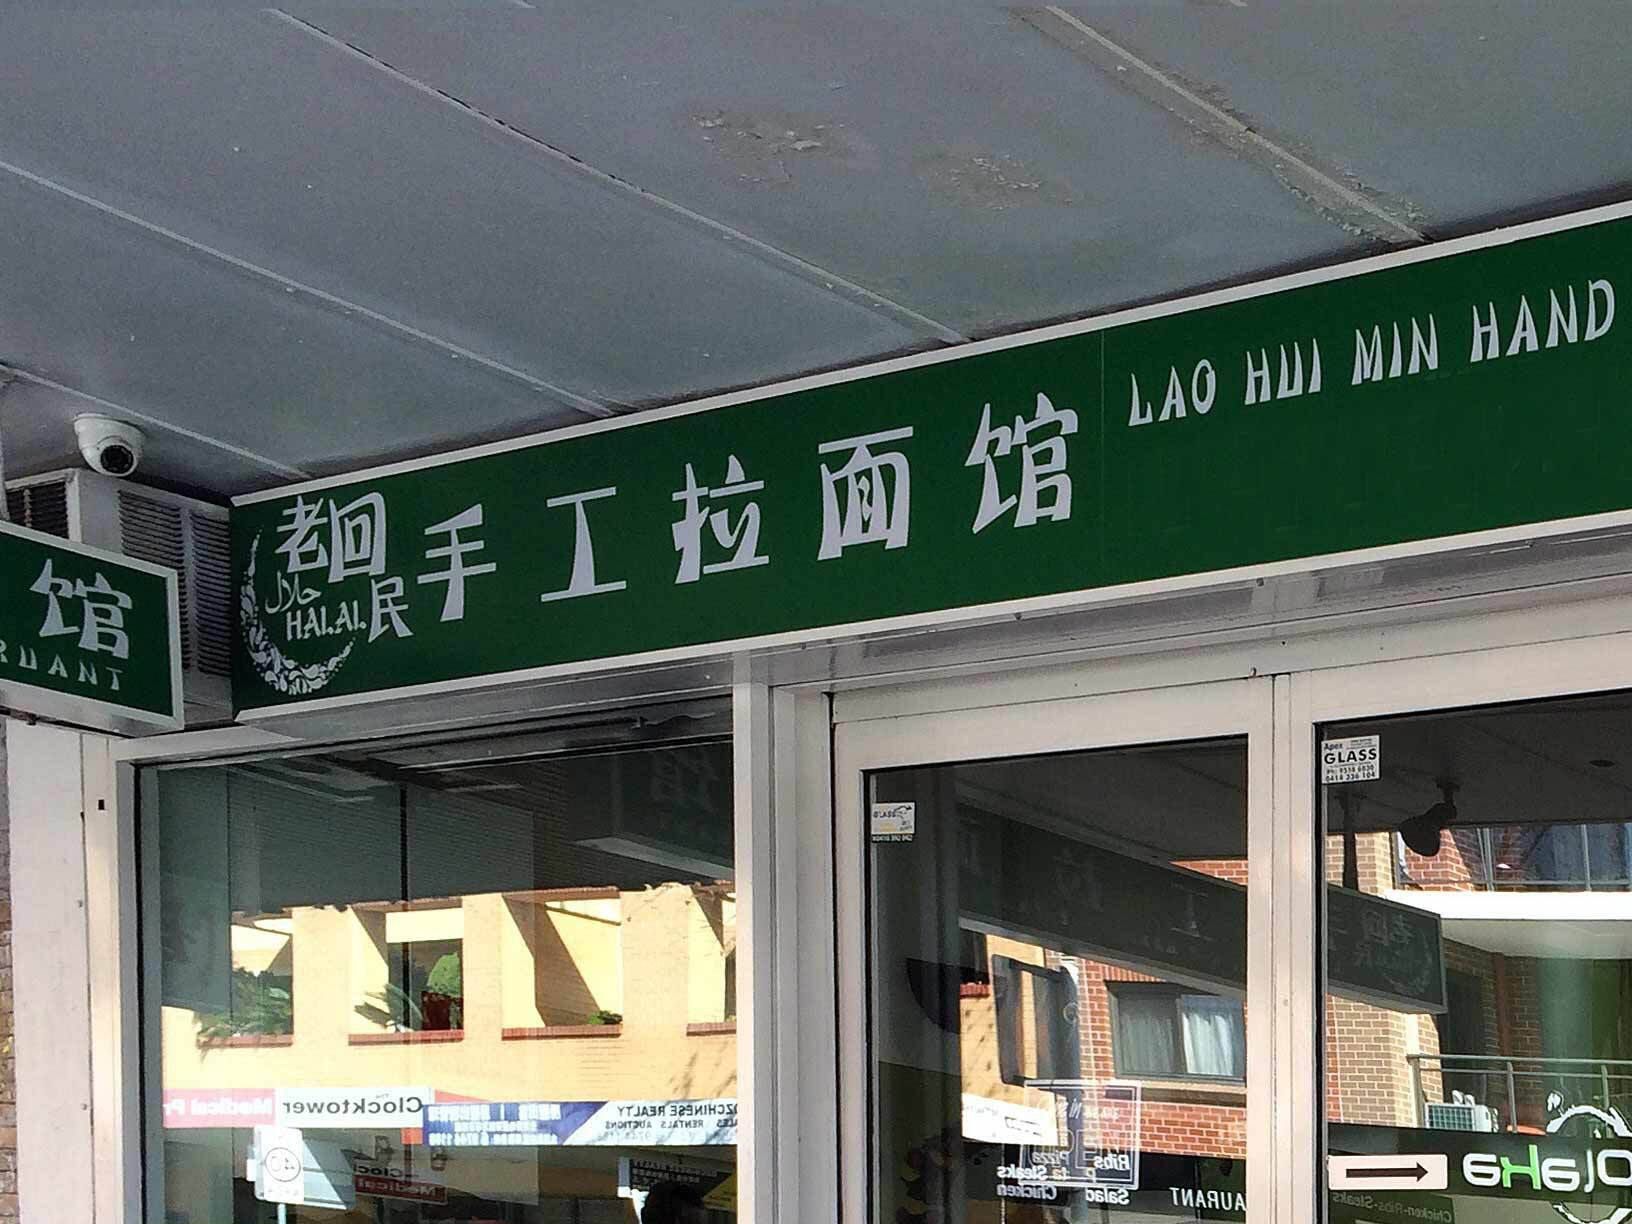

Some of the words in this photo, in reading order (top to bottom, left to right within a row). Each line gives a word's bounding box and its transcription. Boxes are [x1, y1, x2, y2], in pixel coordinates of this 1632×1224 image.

[1128, 358, 1217, 427] LAO
[1243, 337, 1322, 405] HUI
[1350, 312, 1439, 385] MIN
[1469, 279, 1617, 364] HAND
[29, 557, 134, 660] 馆
[286, 603, 367, 641] HALAL
[1324, 747, 1377, 765] GLASS
